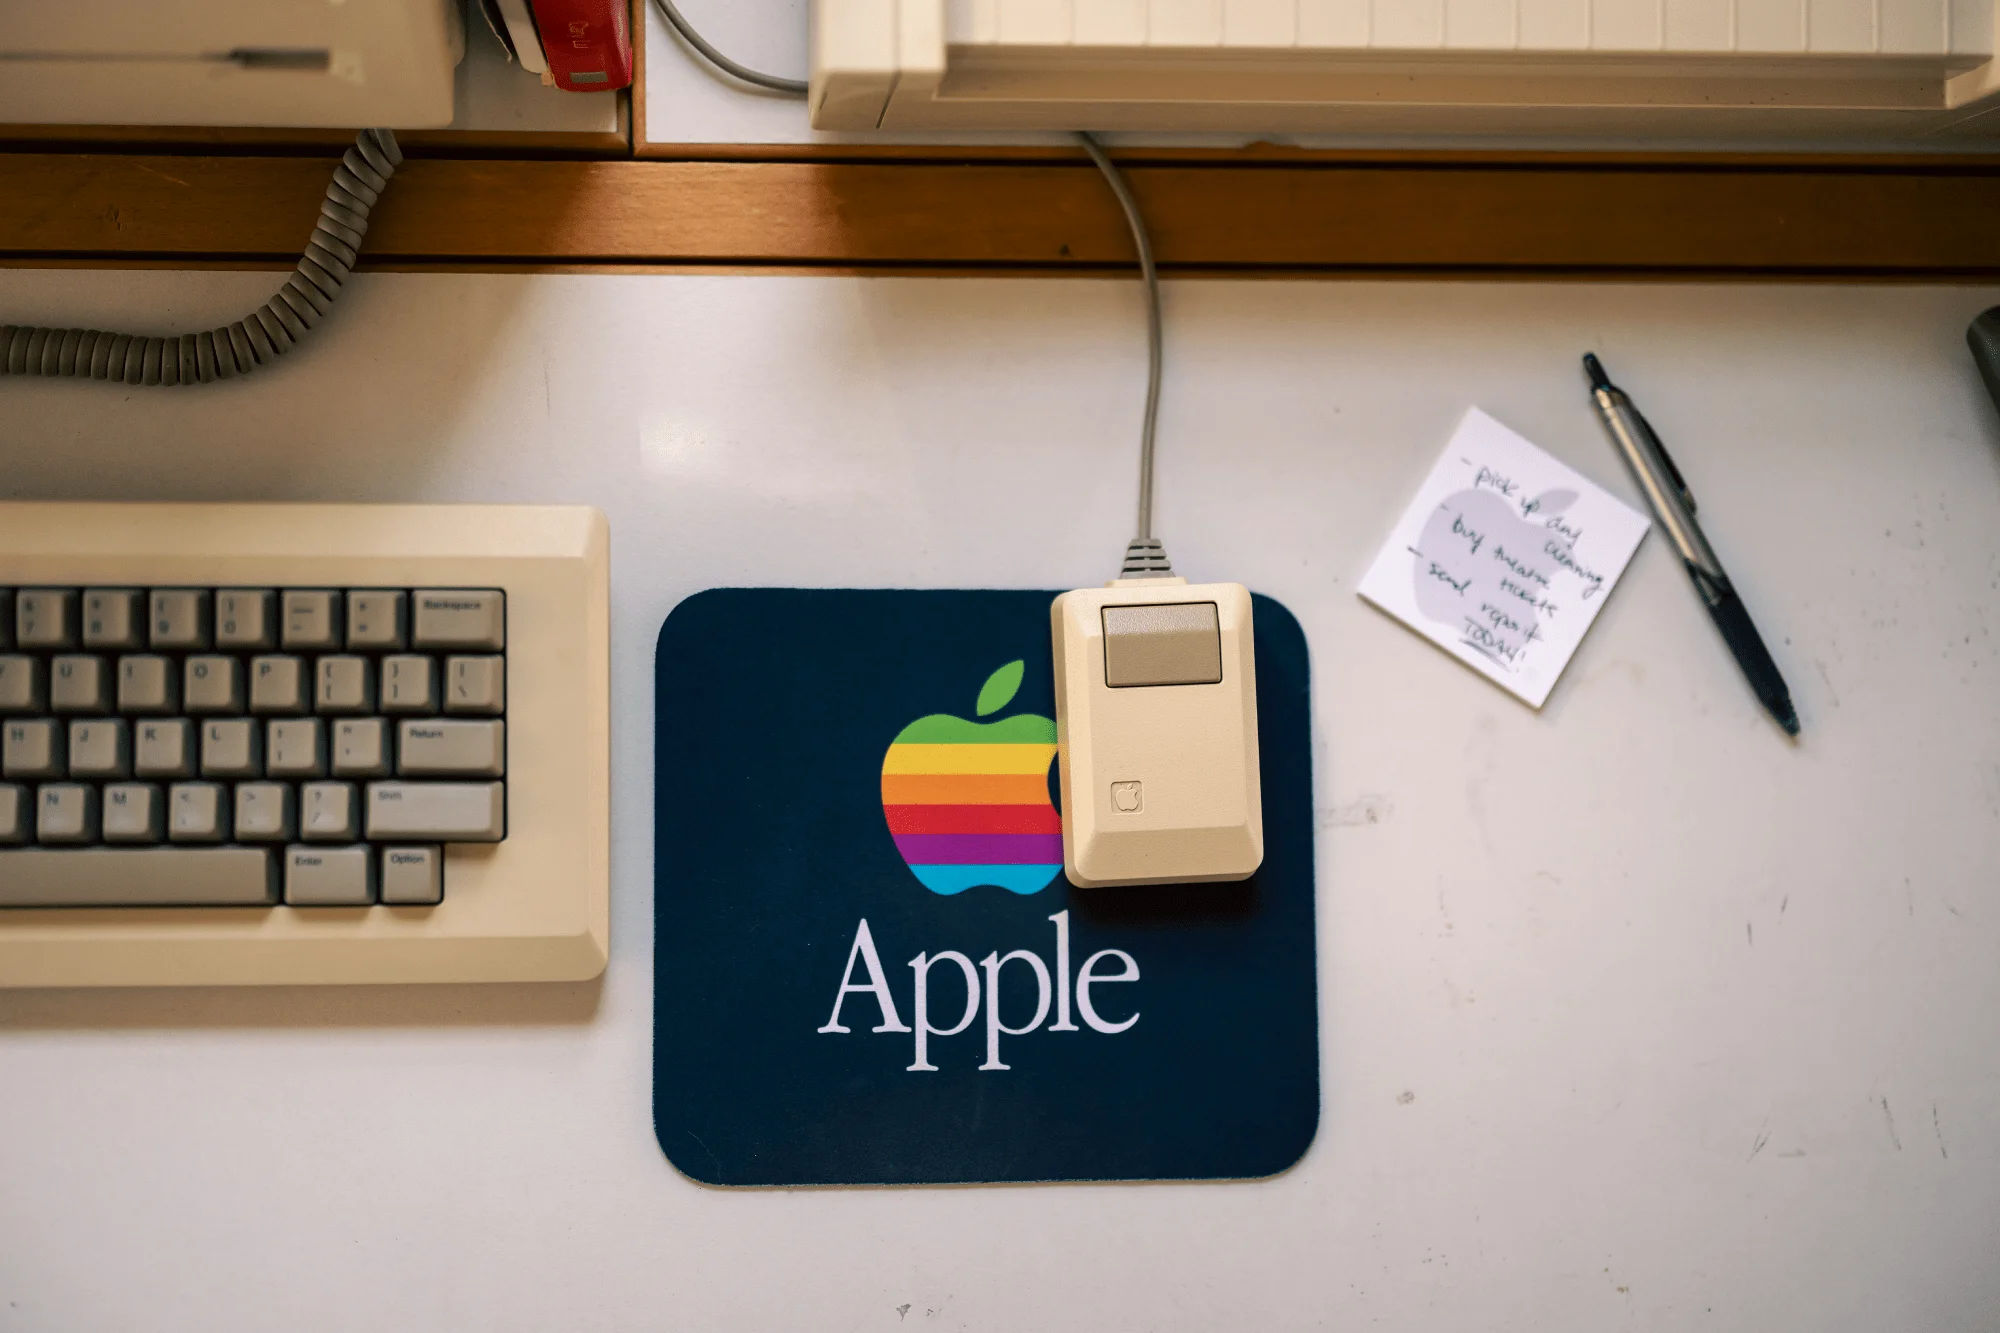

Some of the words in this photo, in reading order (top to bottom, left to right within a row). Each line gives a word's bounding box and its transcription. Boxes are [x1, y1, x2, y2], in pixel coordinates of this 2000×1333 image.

[1475, 466, 1519, 497] pick
[1520, 497, 1541, 518] up
[1452, 512, 1485, 554] buy
[1428, 561, 1473, 598] send
[817, 909, 1140, 1072] Apple
